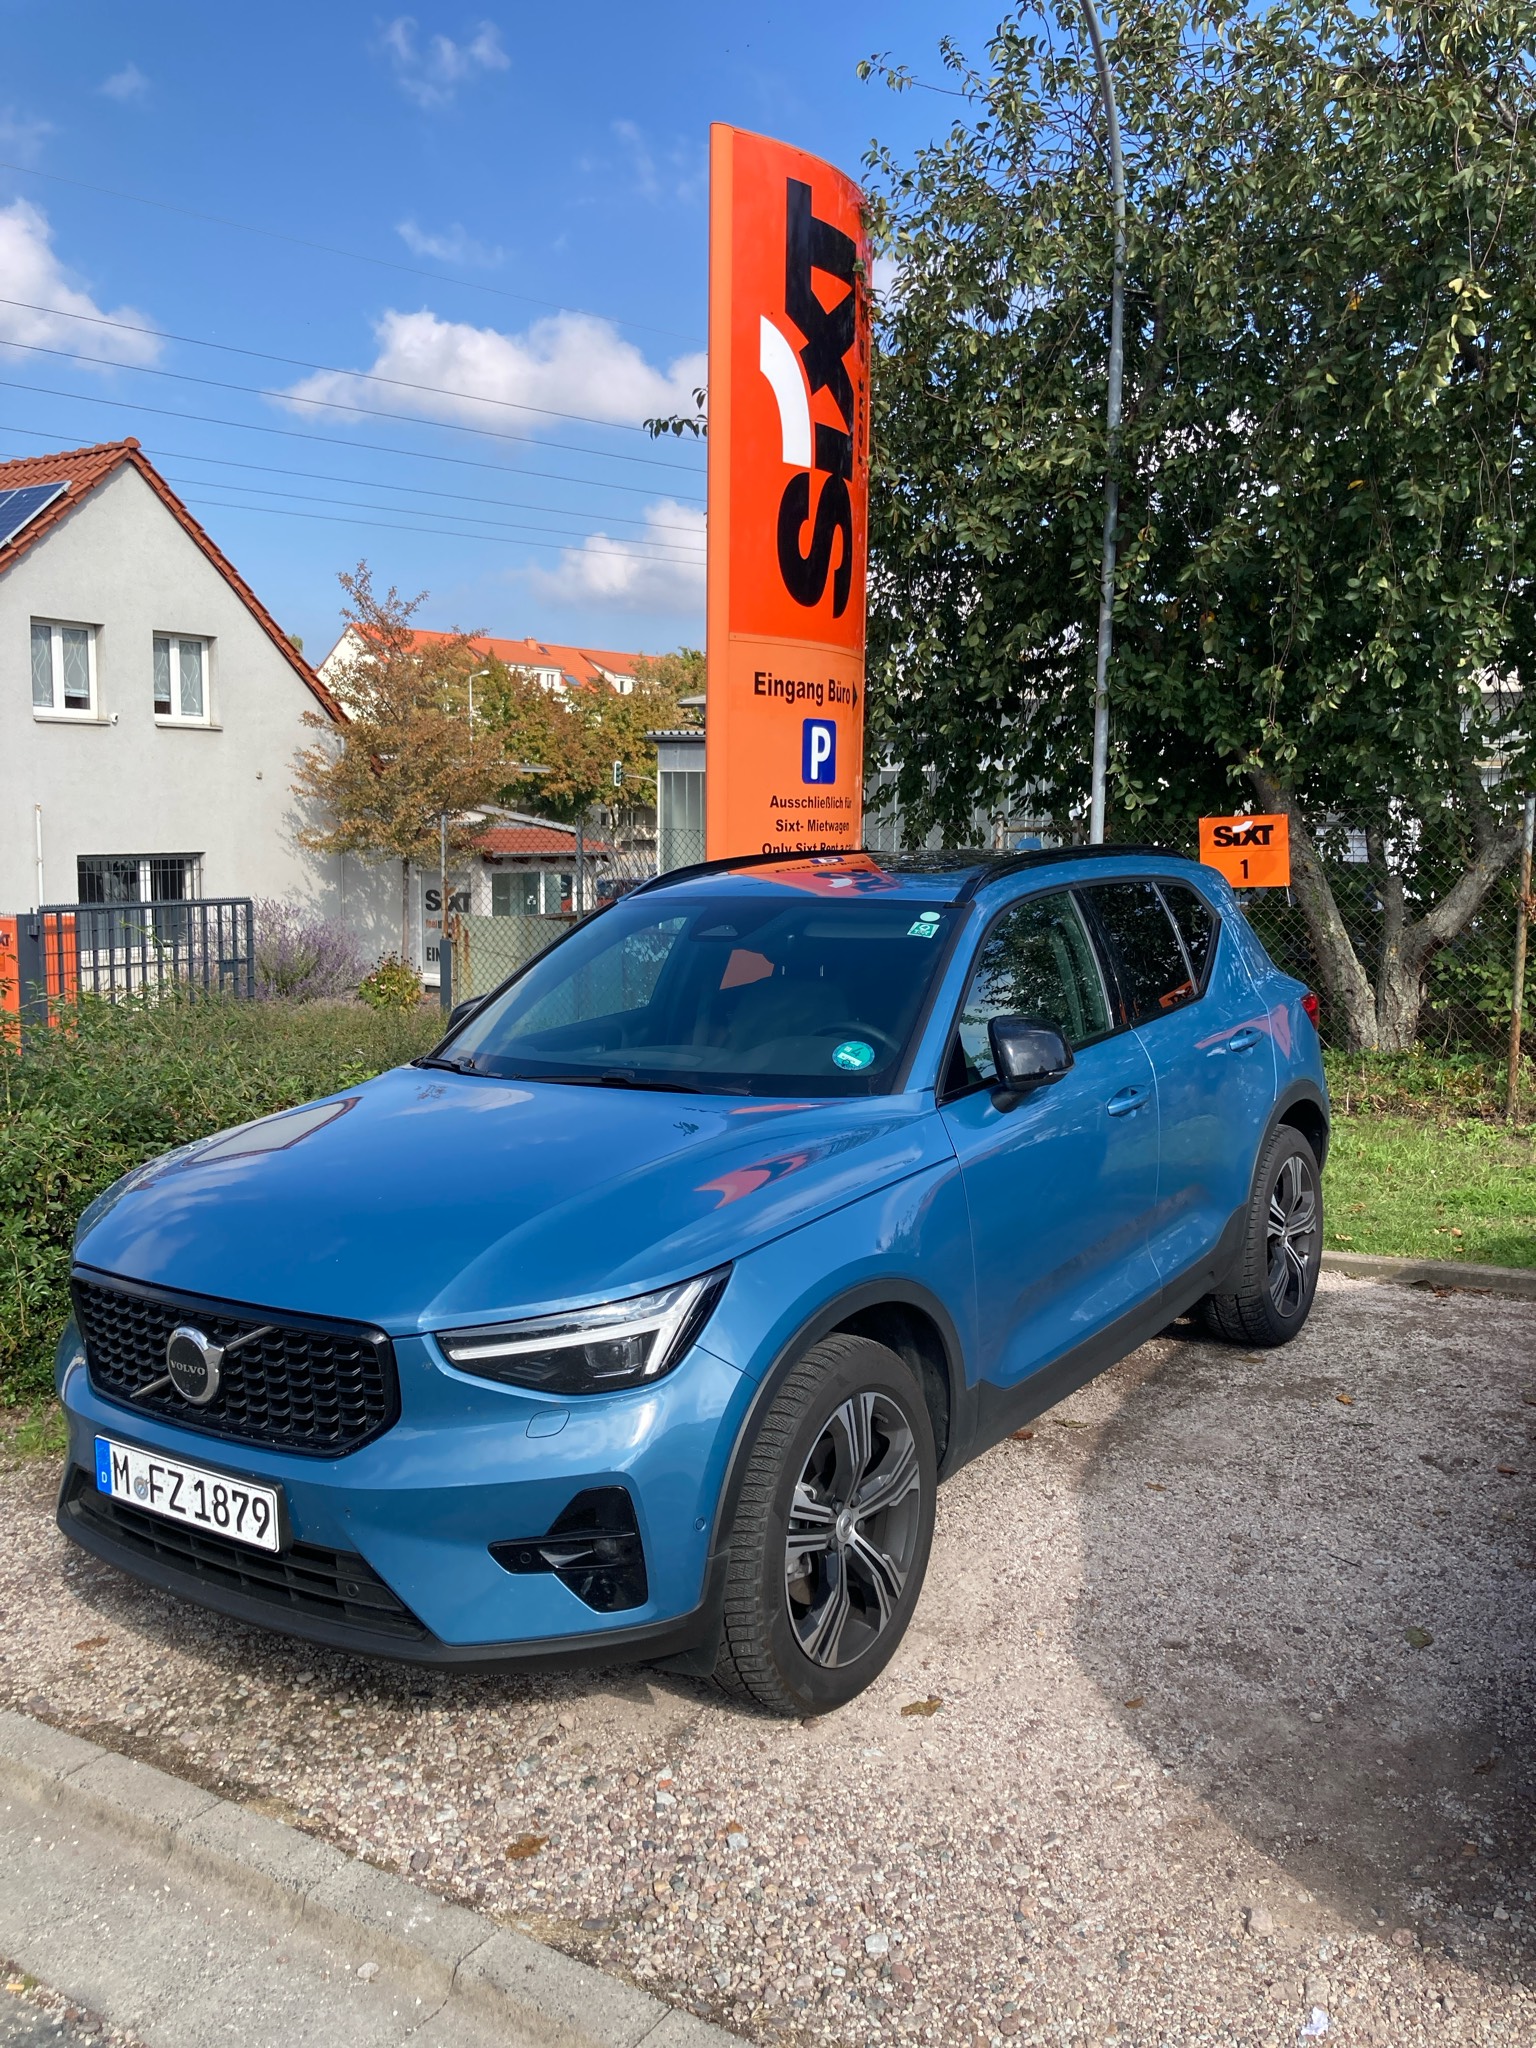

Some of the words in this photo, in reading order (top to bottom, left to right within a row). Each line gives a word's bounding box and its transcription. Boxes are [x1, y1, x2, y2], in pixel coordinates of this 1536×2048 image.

[754, 671, 824, 707] Eingang
[828, 679, 851, 705] Büro
[810, 726, 831, 780] P
[770, 795, 844, 809] Ausschließlich
[775, 818, 804, 832] Sixt-
[807, 819, 850, 835] Mietwagen
[762, 842, 792, 854] Only
[796, 842, 817, 852] Sixt
[1240, 859, 1249, 879] 1
[425, 889, 472, 913] SXT
[170, 1359, 206, 1376] VOLVO
[101, 1471, 108, 1484] D
[112, 1450, 131, 1495] M
